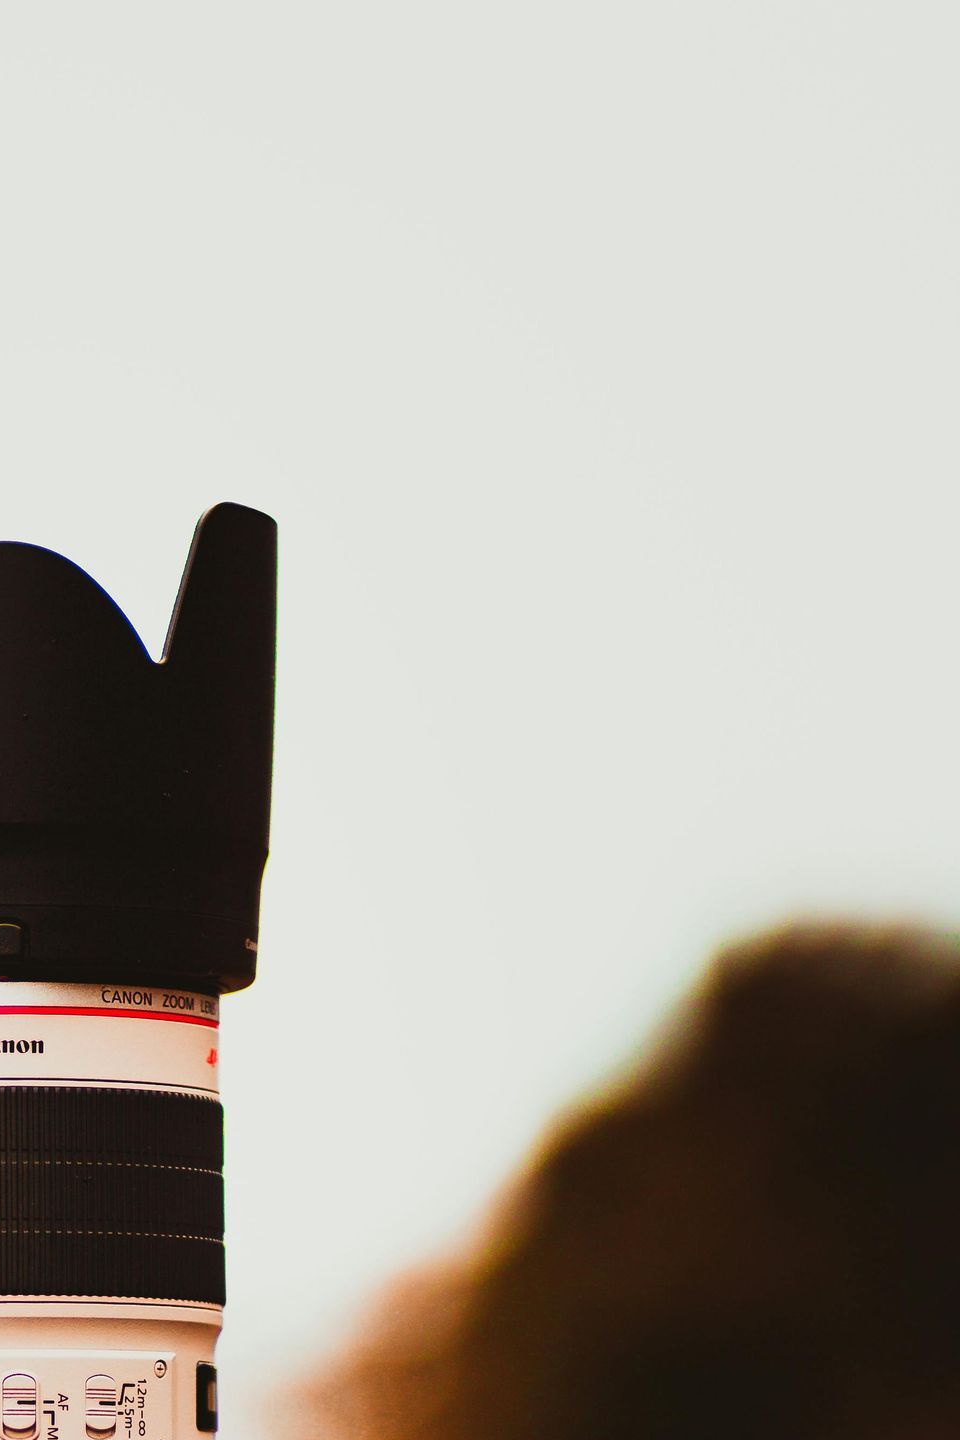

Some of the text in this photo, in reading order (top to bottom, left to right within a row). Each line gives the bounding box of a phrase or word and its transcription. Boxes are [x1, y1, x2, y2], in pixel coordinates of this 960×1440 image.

[101, 989, 152, 1006] CANON
[162, 994, 195, 1011] ZOOM
[58, 1393, 69, 1412] AF
